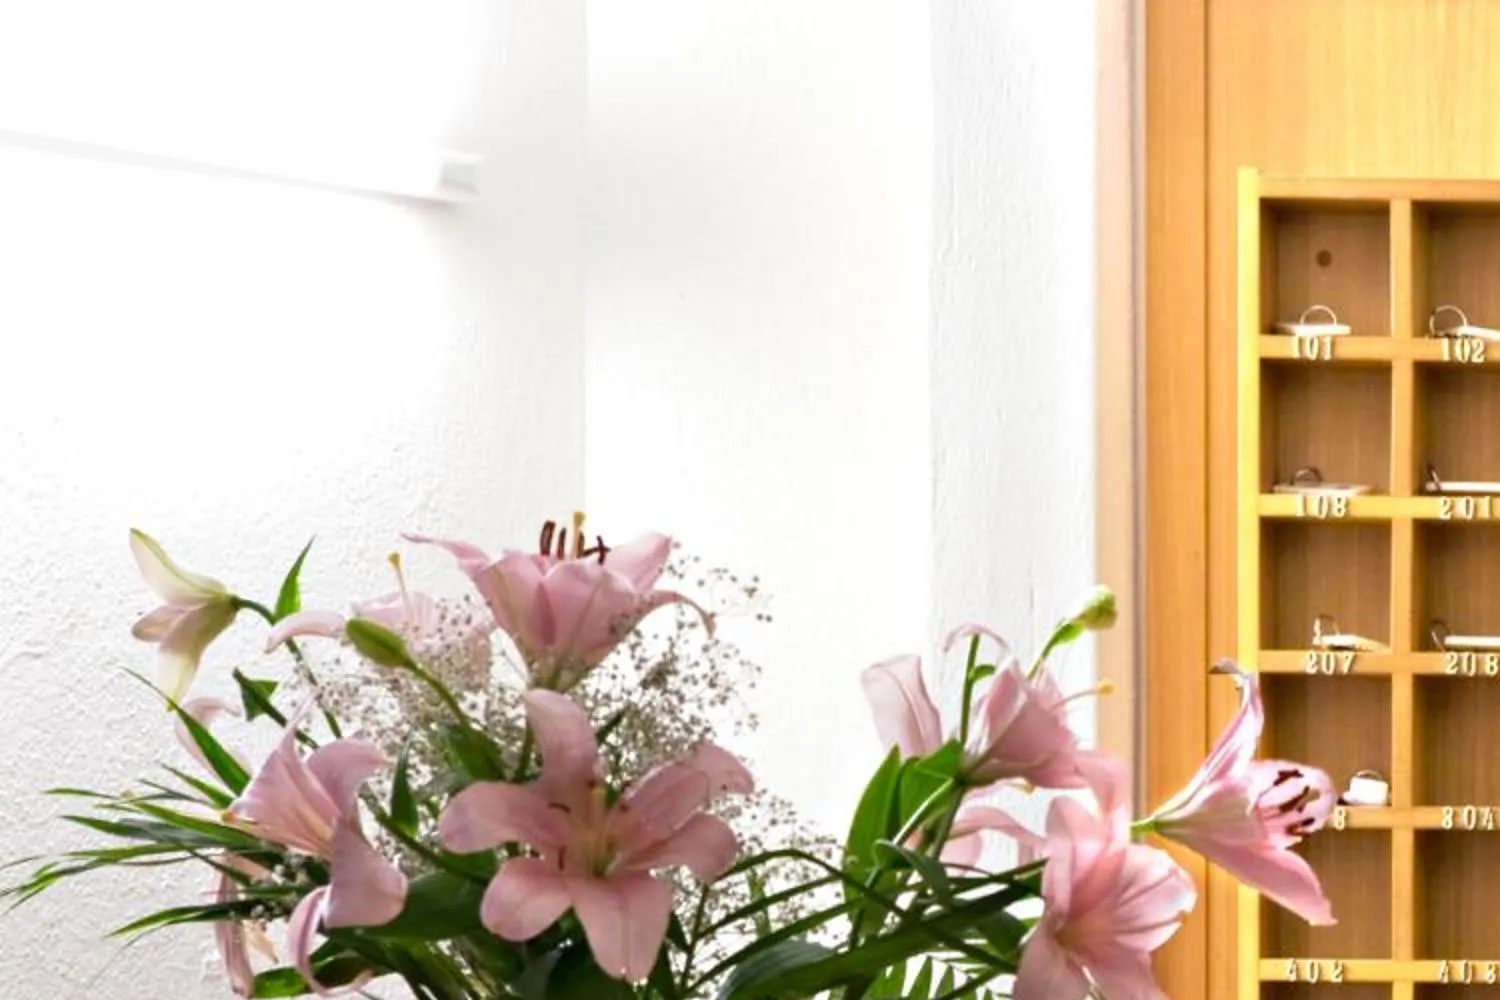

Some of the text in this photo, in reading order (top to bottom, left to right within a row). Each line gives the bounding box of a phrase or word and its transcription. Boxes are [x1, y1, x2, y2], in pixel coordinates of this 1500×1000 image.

[1290, 336, 1332, 361] 101
[1442, 337, 1485, 363] 102
[1296, 495, 1347, 519] 108
[1439, 496, 1491, 520] 201
[1305, 650, 1355, 675] 207
[1445, 651, 1499, 676] 208
[1287, 958, 1343, 984] 402
